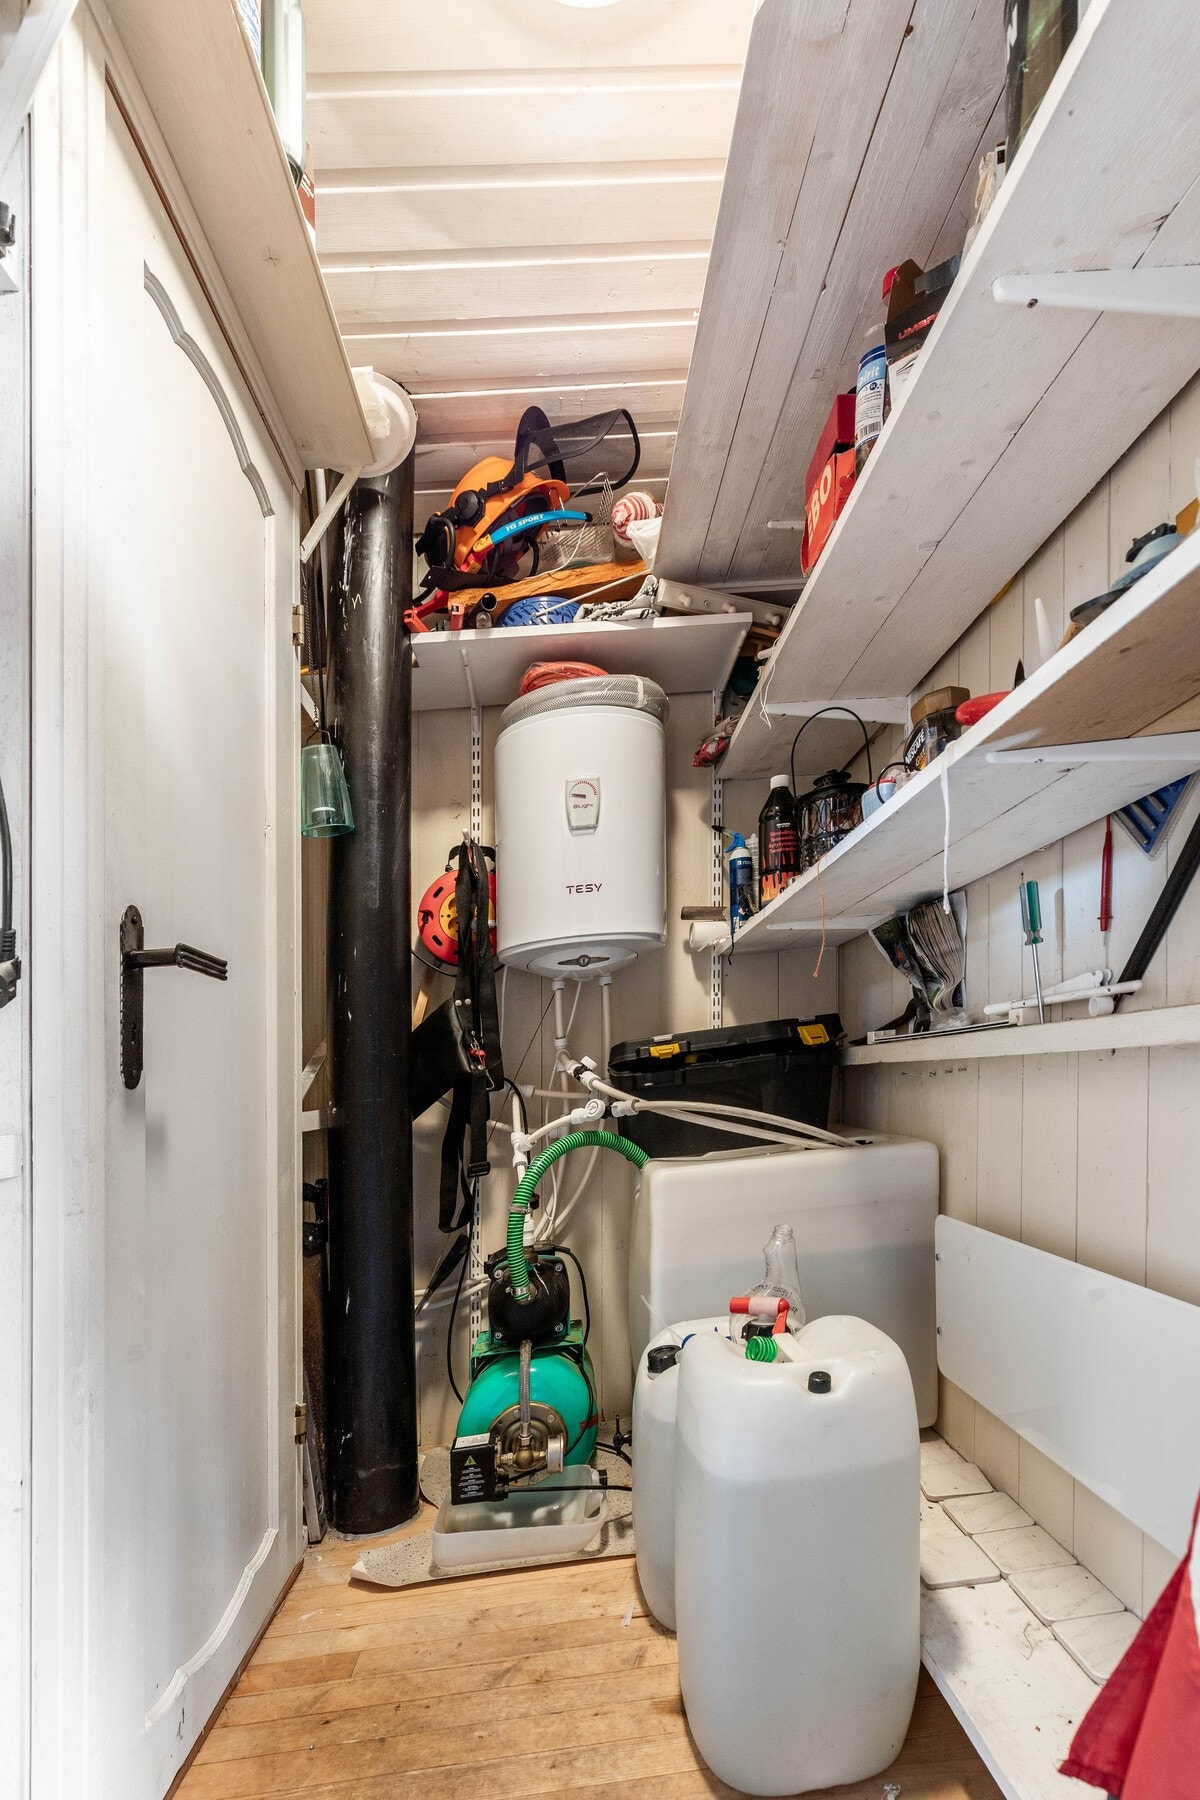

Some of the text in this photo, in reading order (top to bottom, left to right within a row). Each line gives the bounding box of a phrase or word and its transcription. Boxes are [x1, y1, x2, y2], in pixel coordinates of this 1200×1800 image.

[898, 312, 940, 340] UMBR
[518, 513, 544, 527] SPORT
[566, 883, 603, 895] TESY
